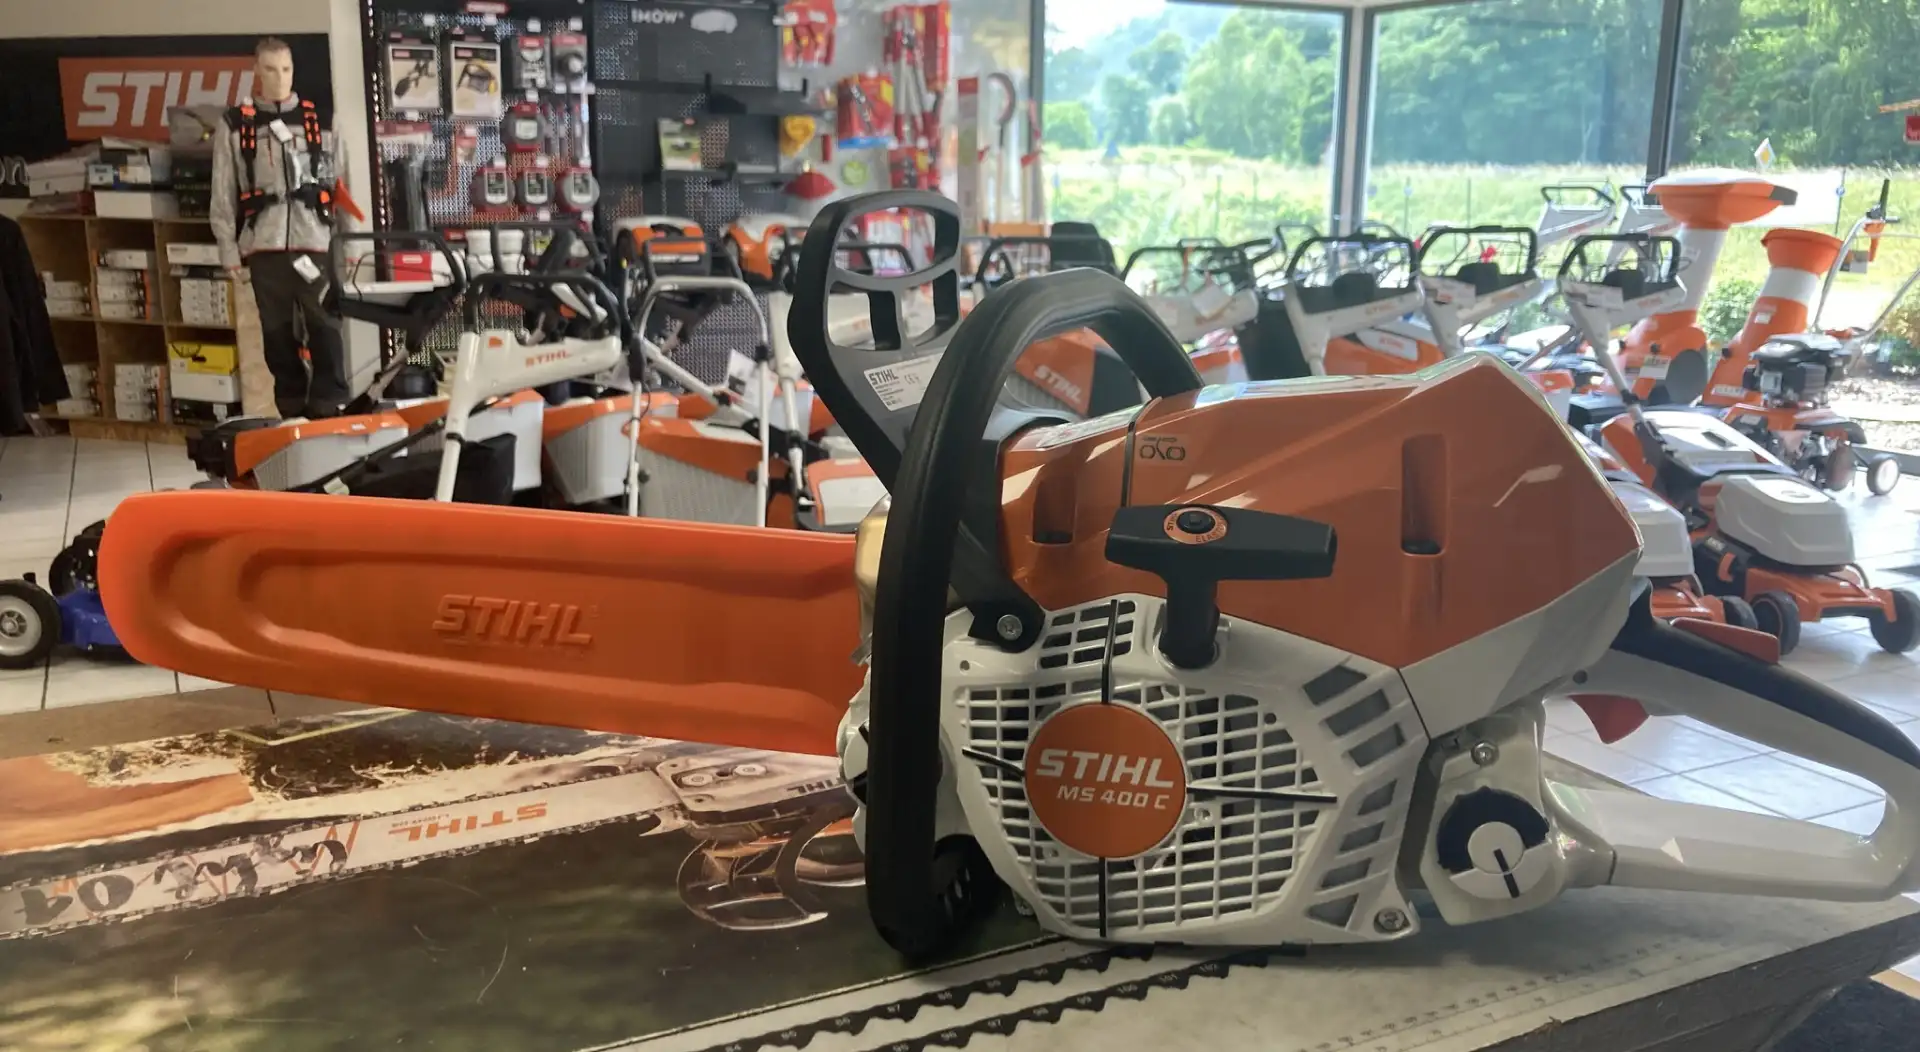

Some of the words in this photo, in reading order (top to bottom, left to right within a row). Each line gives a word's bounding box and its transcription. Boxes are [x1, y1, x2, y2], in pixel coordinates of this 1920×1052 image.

[869, 369, 899, 385] STIHL
[1033, 364, 1082, 404] STIHL
[433, 594, 592, 644] STIHL
[1036, 749, 1174, 788] STIHL
[1057, 785, 1096, 802] MS
[1101, 790, 1149, 808] 400
[1154, 795, 1170, 809] C
[388, 802, 547, 841] STIHL
